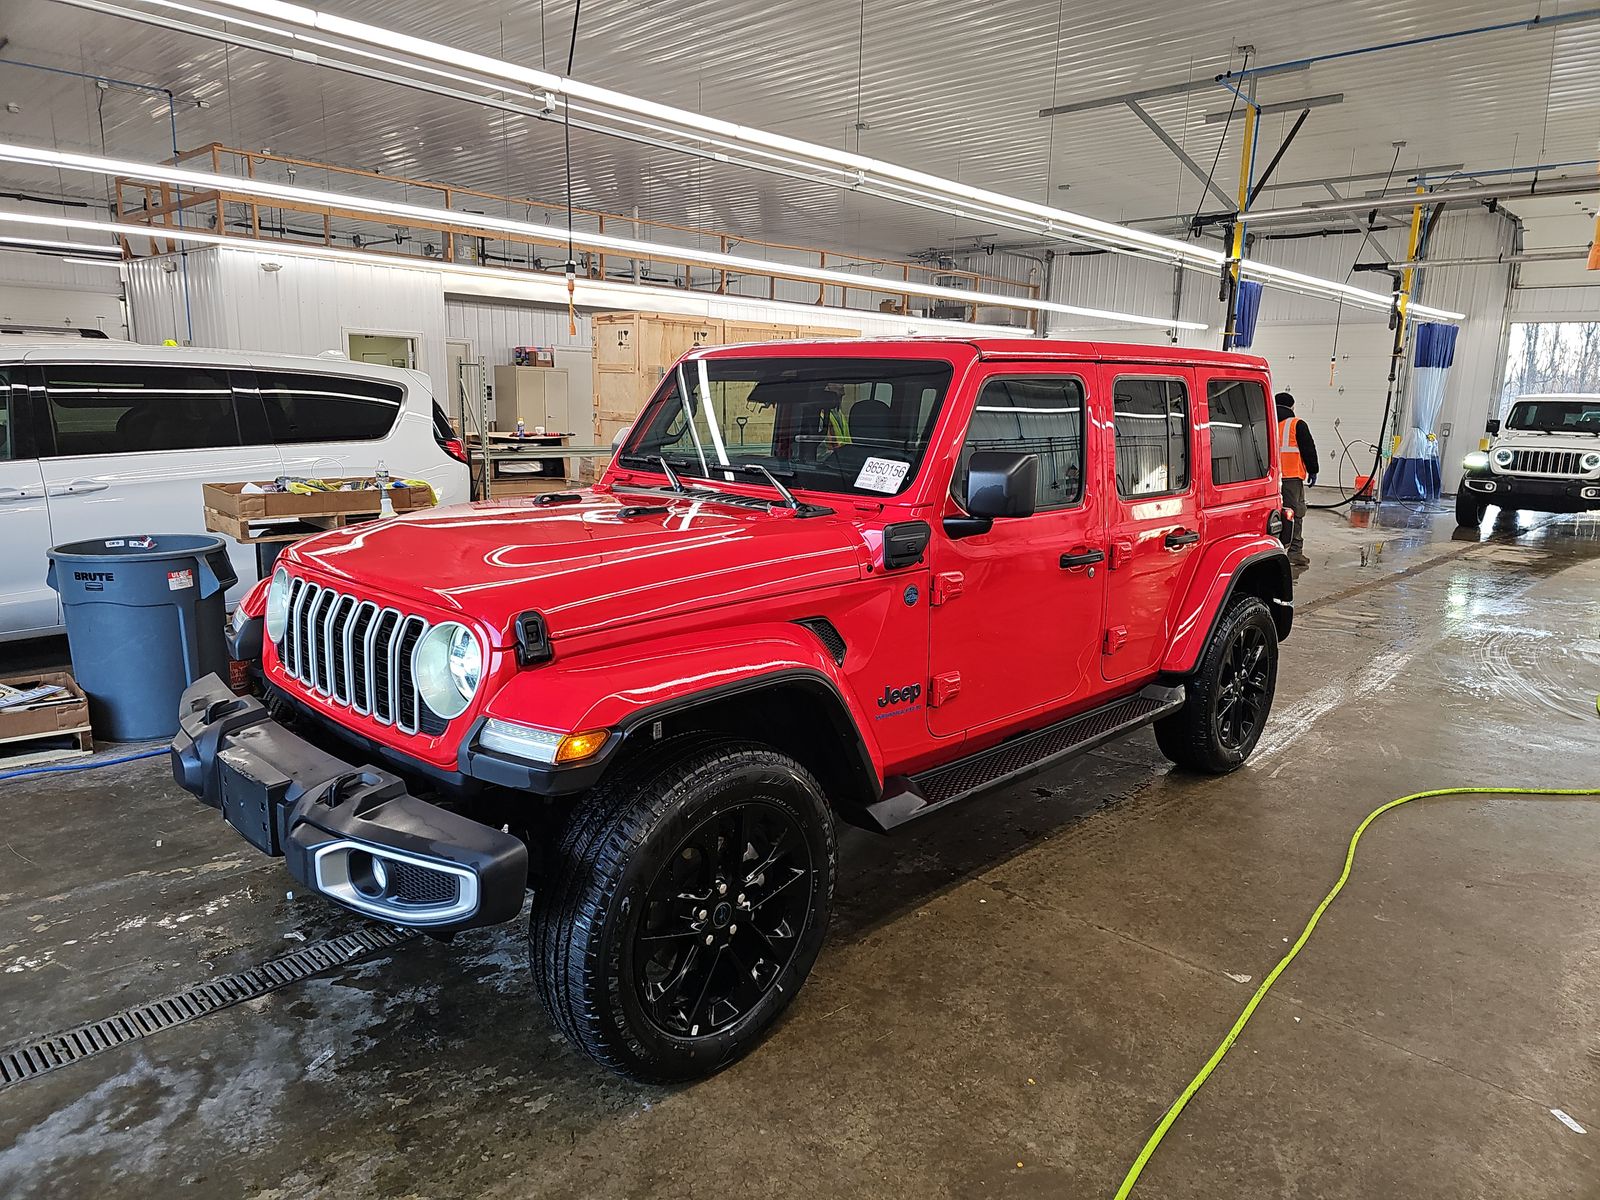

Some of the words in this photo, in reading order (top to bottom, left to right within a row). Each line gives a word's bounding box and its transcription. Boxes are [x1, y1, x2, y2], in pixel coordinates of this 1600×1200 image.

[865, 461, 907, 478] 8650156
[74, 571, 115, 582] BRUTE
[878, 682, 922, 708] Jeep
